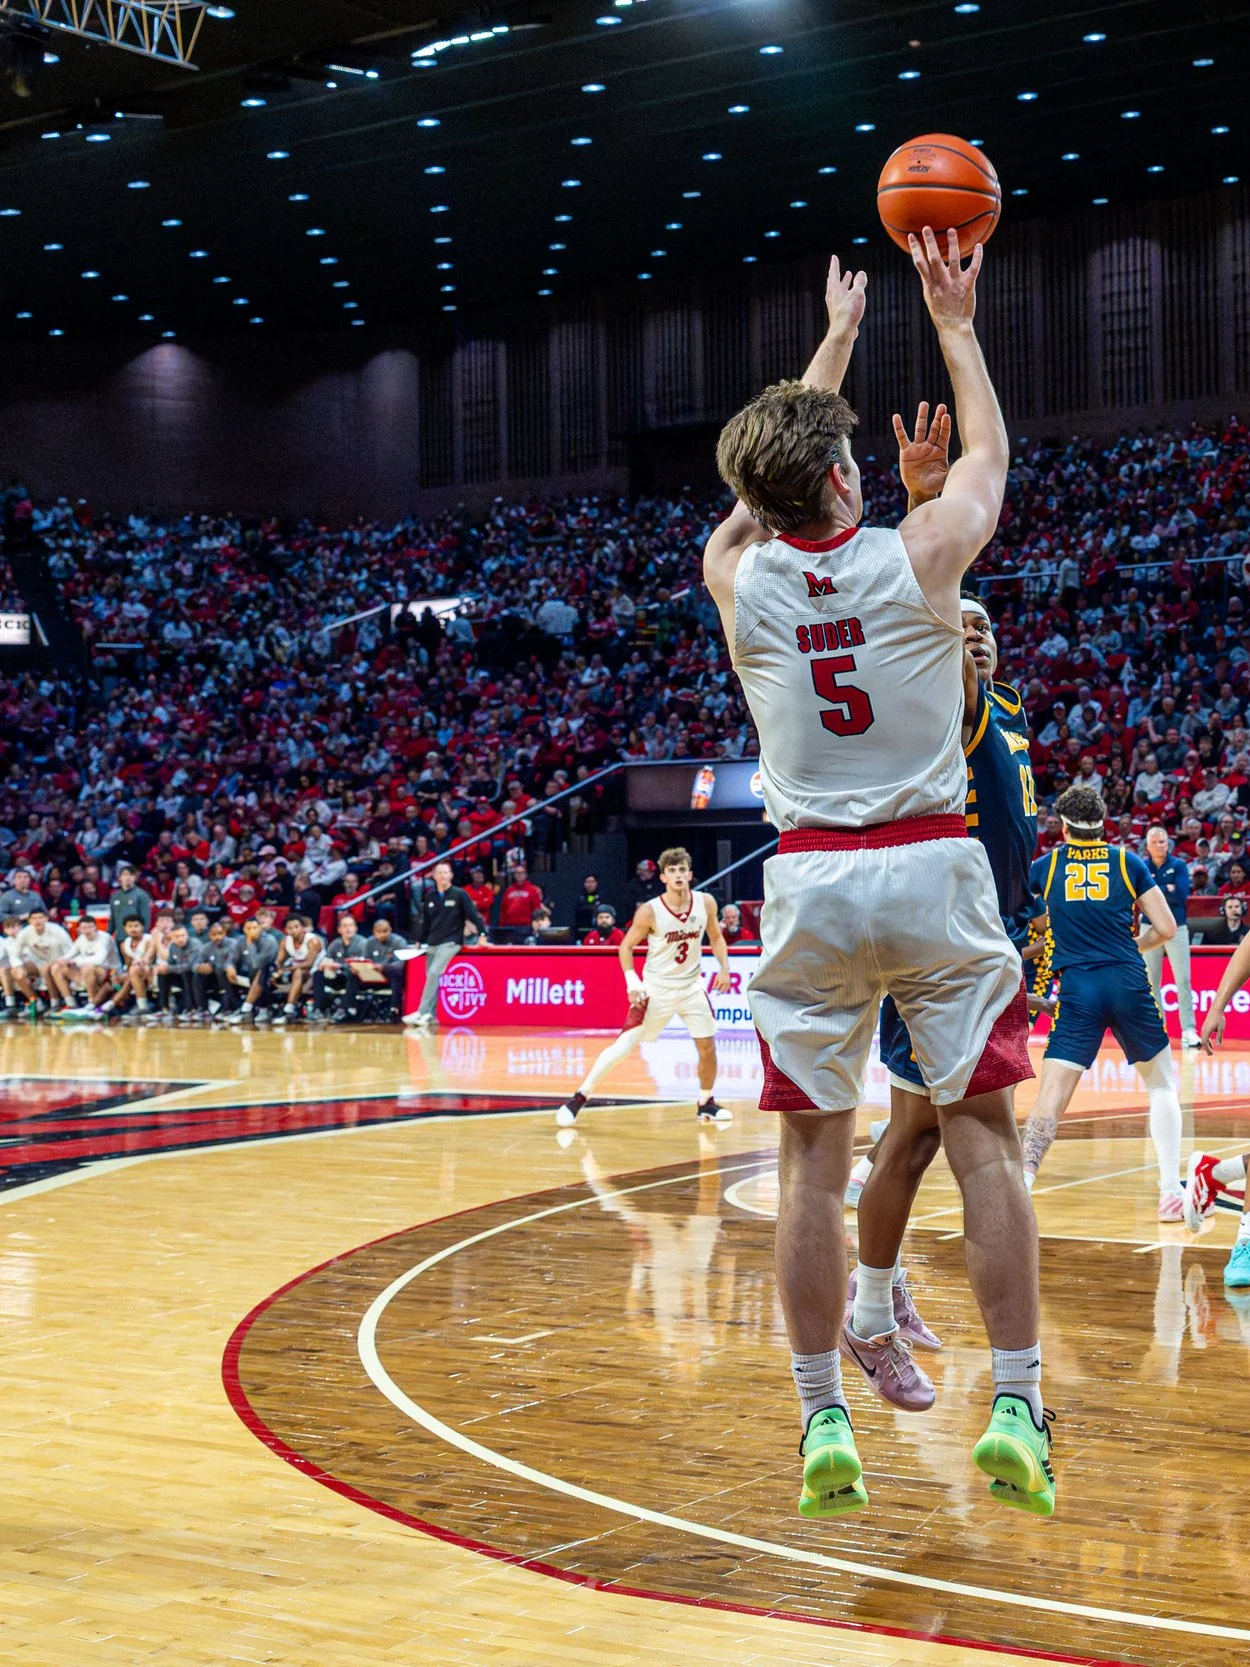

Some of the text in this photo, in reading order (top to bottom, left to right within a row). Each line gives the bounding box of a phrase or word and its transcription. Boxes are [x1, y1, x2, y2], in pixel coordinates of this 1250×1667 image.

[802, 571, 839, 597] M
[795, 616, 866, 654] SUDER
[810, 653, 875, 737] 5
[1067, 847, 1109, 860] PARKS
[1065, 862, 1110, 902] 25
[675, 942, 689, 964] 3
[465, 992, 487, 1007] IVY
[506, 977, 585, 1006] Millett
